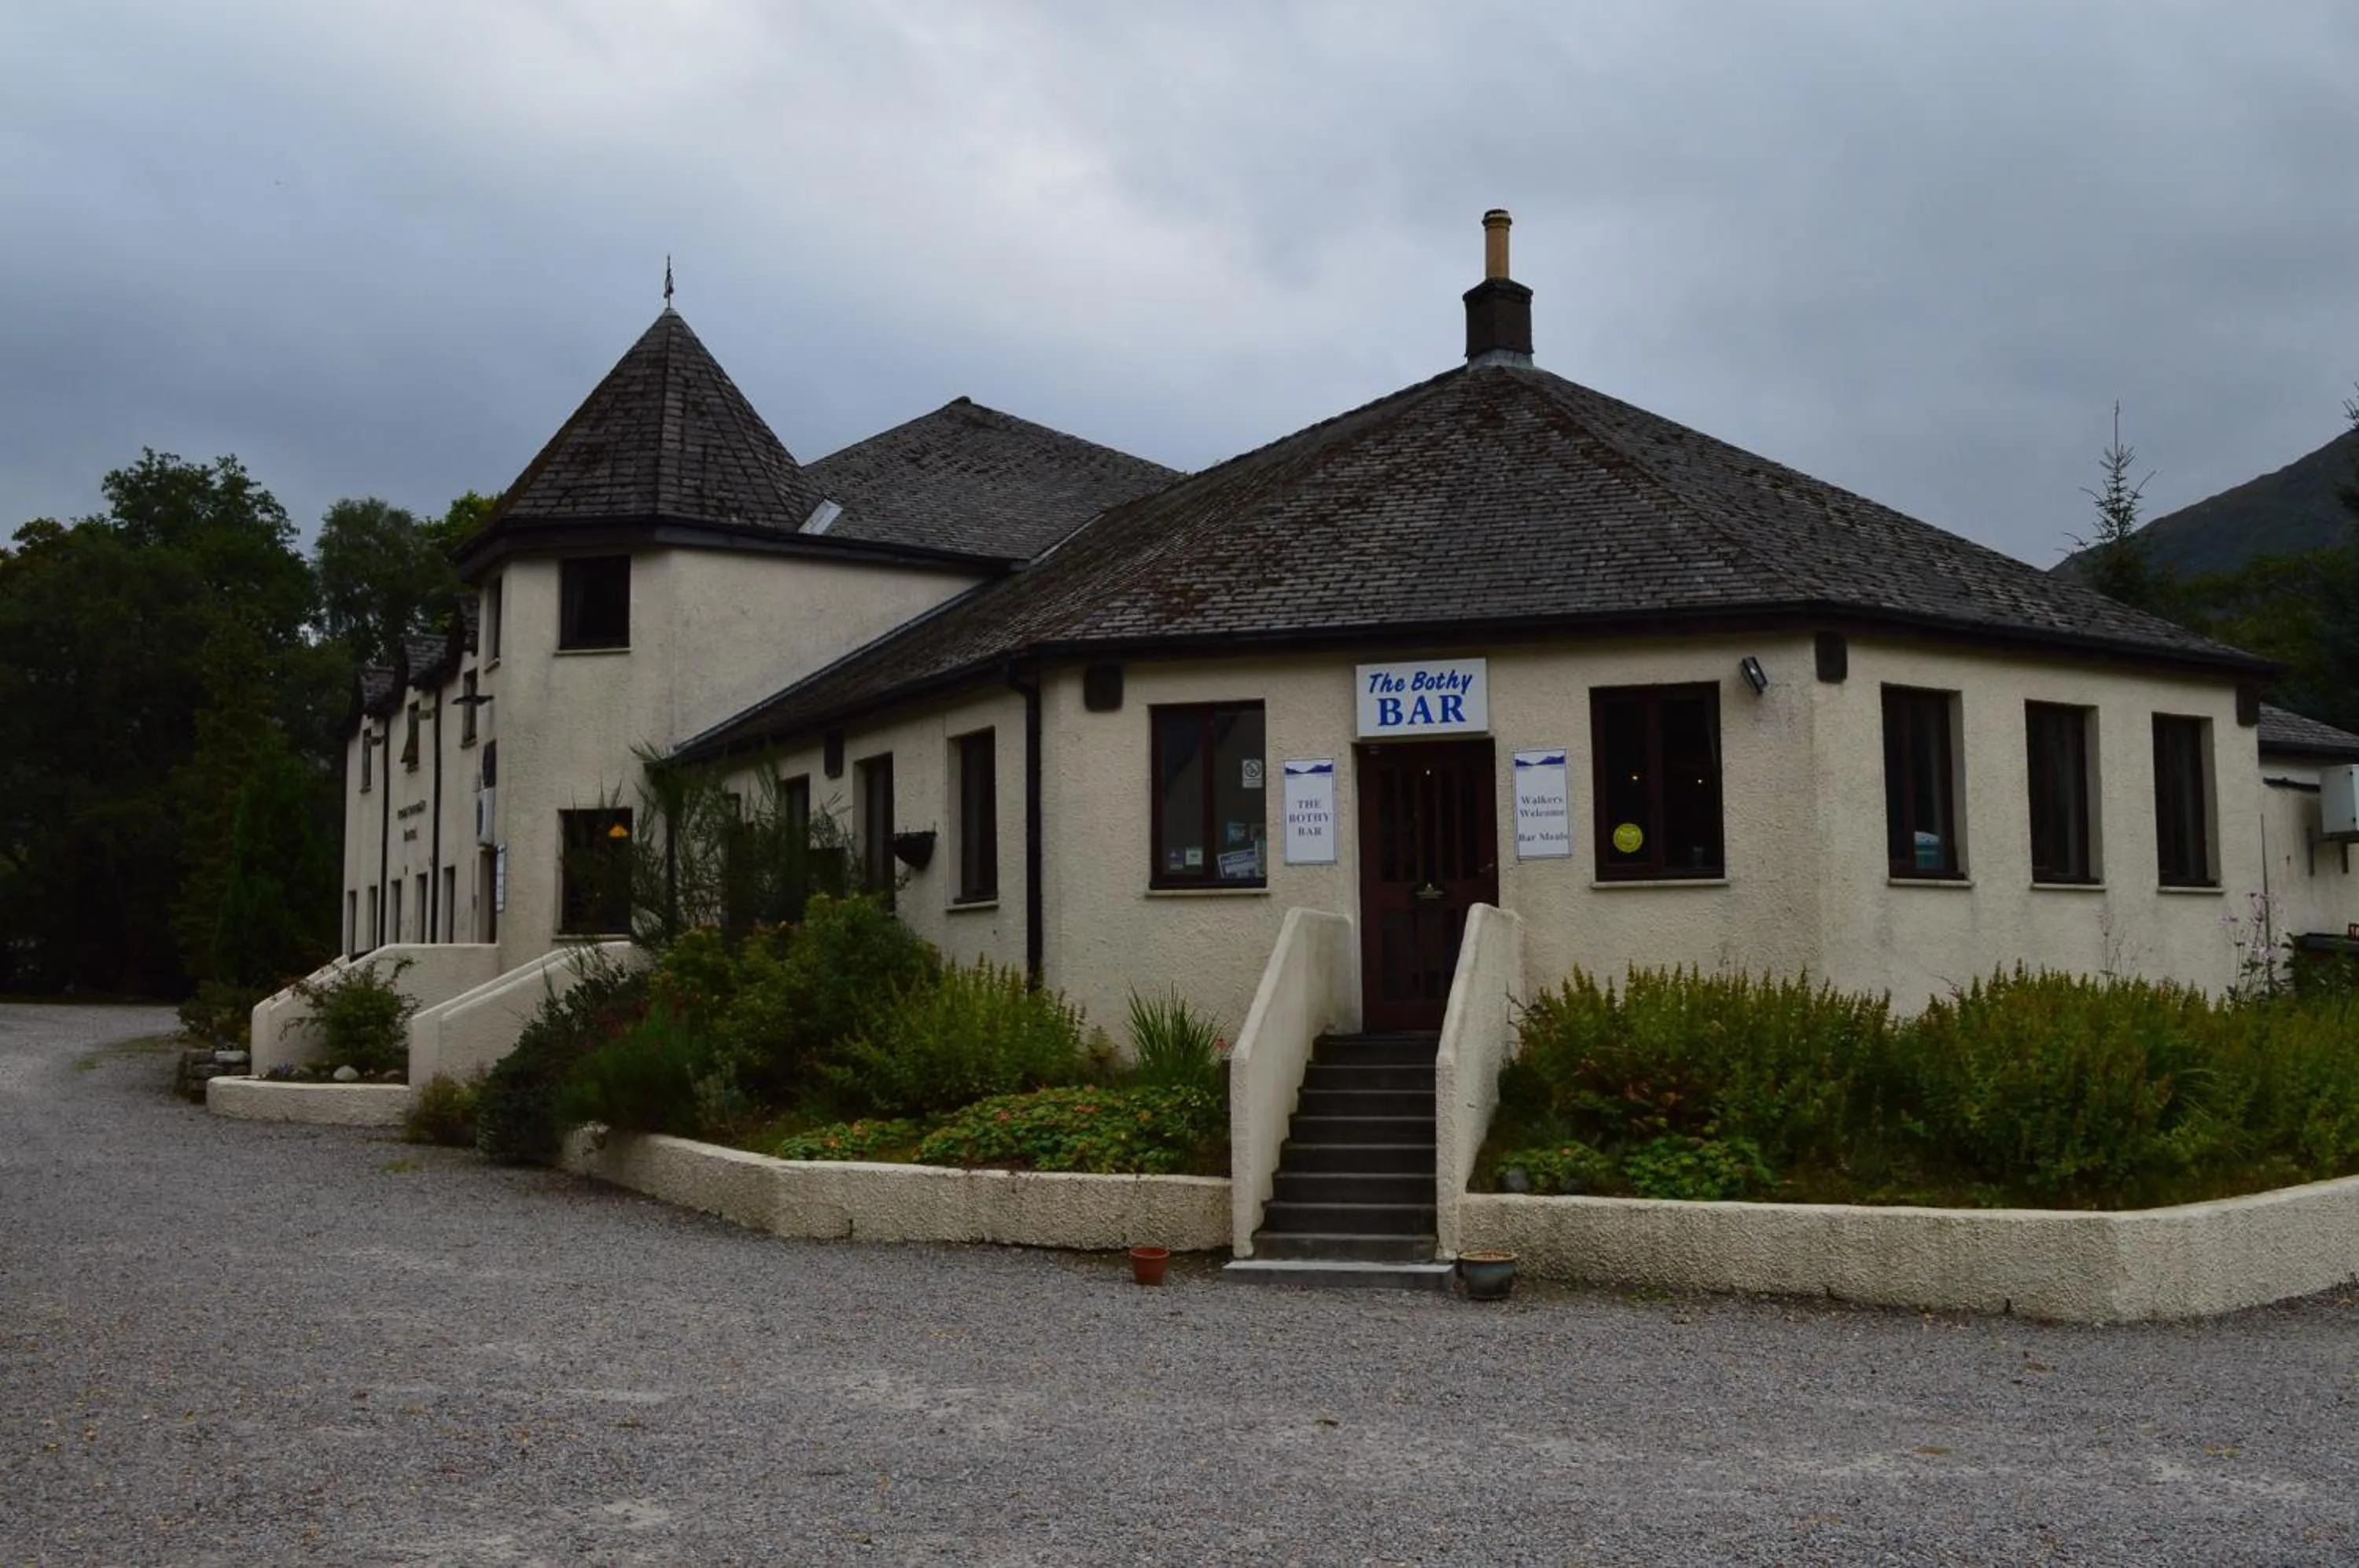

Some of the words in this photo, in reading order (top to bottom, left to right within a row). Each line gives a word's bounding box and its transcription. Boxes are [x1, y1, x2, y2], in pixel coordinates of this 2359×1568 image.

[1368, 672, 1405, 694] The
[1411, 669, 1473, 695] Bothy
[1377, 694, 1467, 727] BAR
[1297, 799, 1322, 809] THE
[1520, 795, 1563, 804] Walkers
[1288, 812, 1330, 823] BOTHY
[1519, 808, 1566, 818] Welcome
[1297, 826, 1323, 837] BAR
[1518, 833, 1536, 842] Bar
